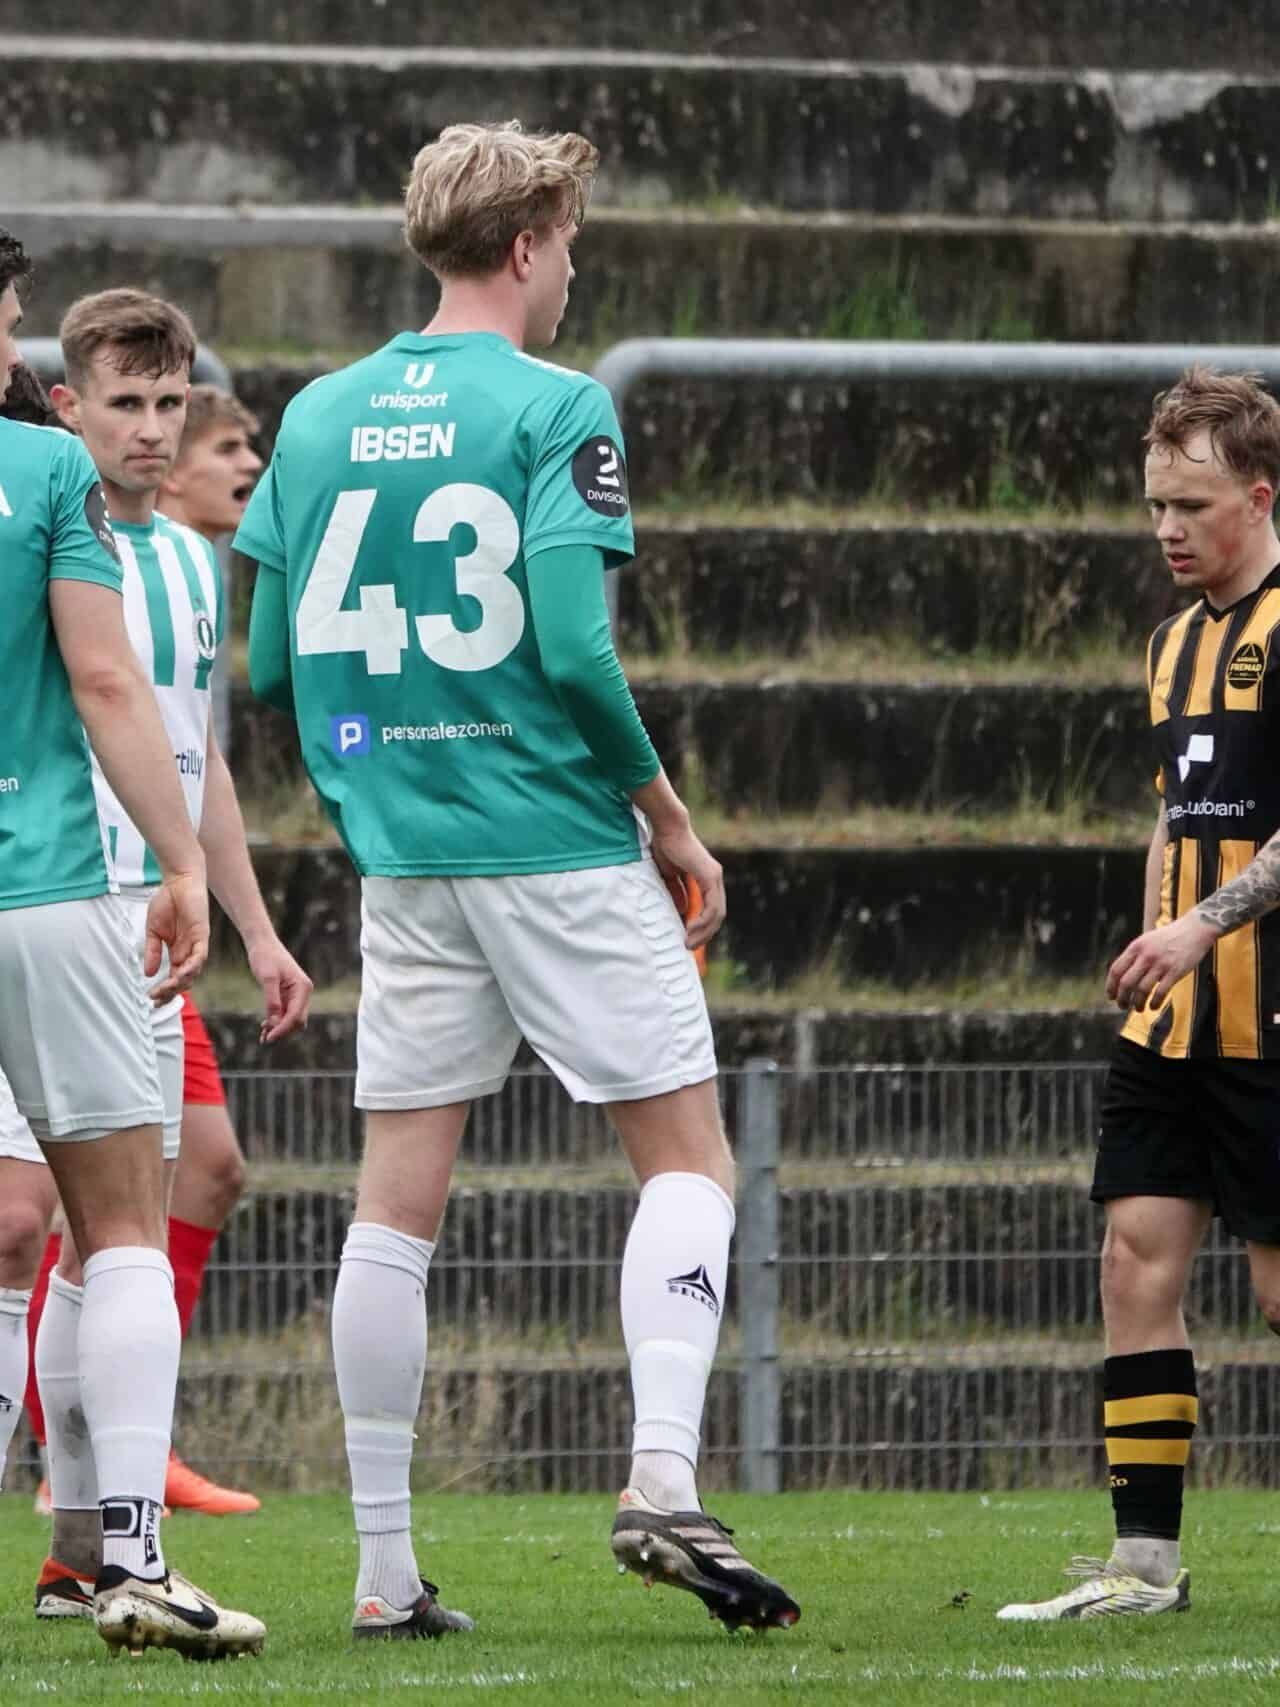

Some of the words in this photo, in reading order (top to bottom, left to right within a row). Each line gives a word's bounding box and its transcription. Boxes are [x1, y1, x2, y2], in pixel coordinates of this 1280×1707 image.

[370, 391, 448, 411] unisport
[350, 422, 456, 462] IBSEN
[595, 444, 620, 488] 2
[296, 482, 525, 675] 43
